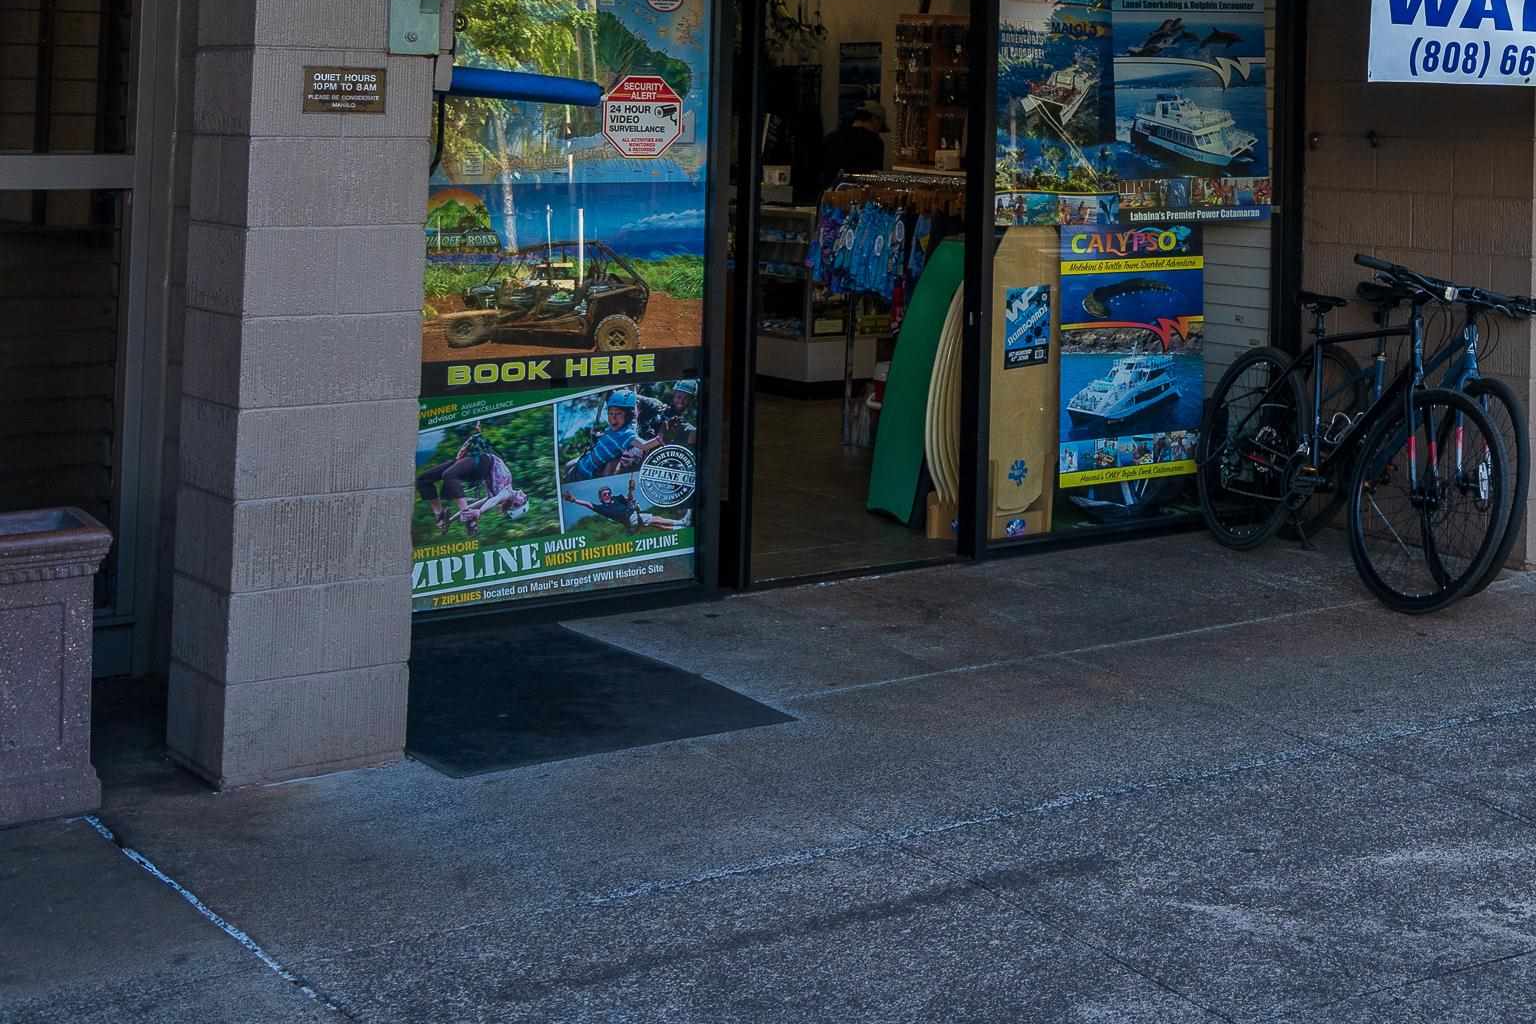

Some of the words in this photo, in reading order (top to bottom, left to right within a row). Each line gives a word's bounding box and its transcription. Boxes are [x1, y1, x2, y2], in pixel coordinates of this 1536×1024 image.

[1409, 37, 1490, 78] (808)
[314, 73, 341, 81] QUIET
[344, 74, 377, 82] HOURS
[340, 83, 353, 91] TO
[624, 82, 664, 90] SECURITY
[630, 92, 657, 100] ALERT
[610, 105, 622, 113] 24
[624, 105, 651, 114] HOUR
[610, 115, 640, 123] VIDEO
[609, 125, 665, 133] SURVEILLANCE
[1130, 210, 1165, 222] Lahaina's
[1166, 209, 1197, 221] Premier
[1197, 209, 1220, 220] Power
[1220, 208, 1260, 219] Catamaran
[1071, 230, 1177, 256] CALYPSO
[447, 359, 552, 385] BOOK
[565, 353, 656, 378] HERE
[642, 468, 680, 481] ZIPLINE
[544, 536, 586, 553] MAUI'S
[544, 550, 578, 567] MOST
[581, 542, 634, 561] HISTORIC
[635, 534, 679, 552] ZIPLINE
[411, 543, 540, 589] ZIPLINE
[483, 585, 516, 599] located
[517, 585, 528, 594] on
[530, 579, 558, 592] Maui's
[560, 574, 591, 588] Largest
[615, 568, 646, 579] Historic
[648, 564, 664, 574] Site
